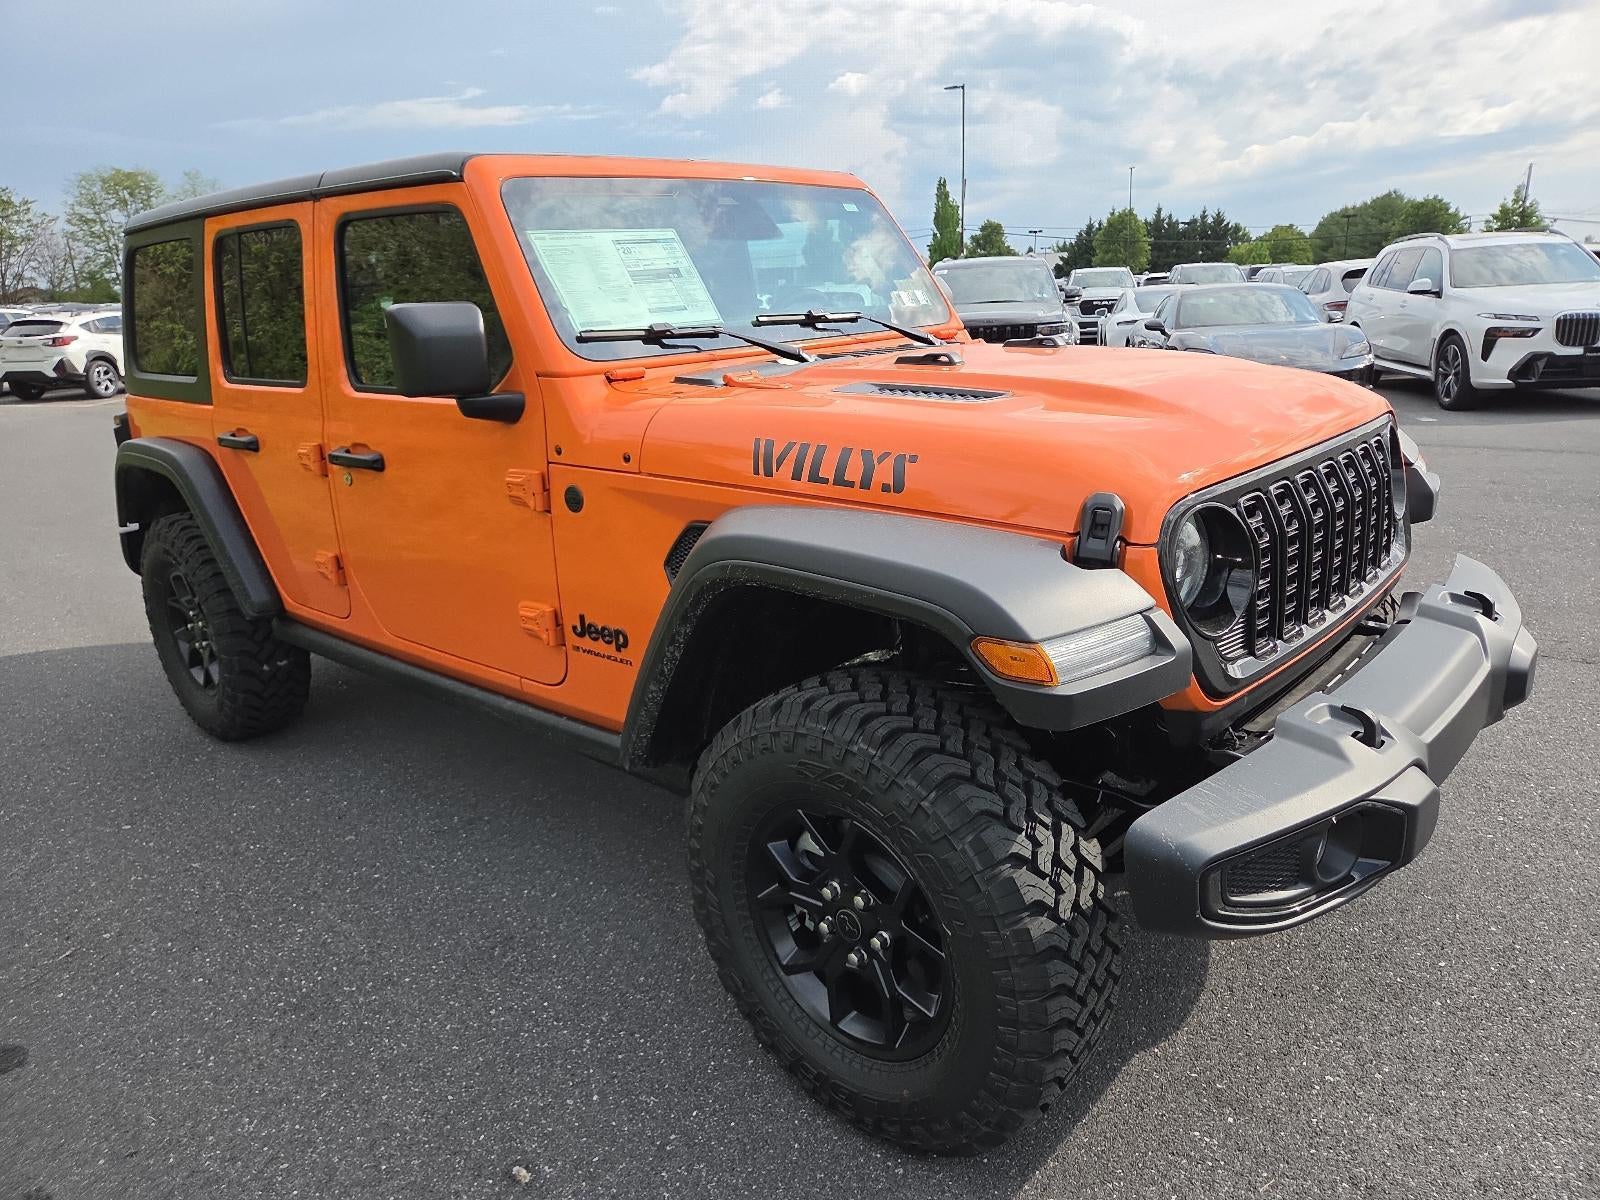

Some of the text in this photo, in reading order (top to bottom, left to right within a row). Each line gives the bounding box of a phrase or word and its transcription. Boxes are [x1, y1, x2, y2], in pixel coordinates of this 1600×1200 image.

[752, 437, 919, 494] WILLYS
[571, 613, 629, 653] Jeep
[580, 646, 633, 667] WRANGLER
